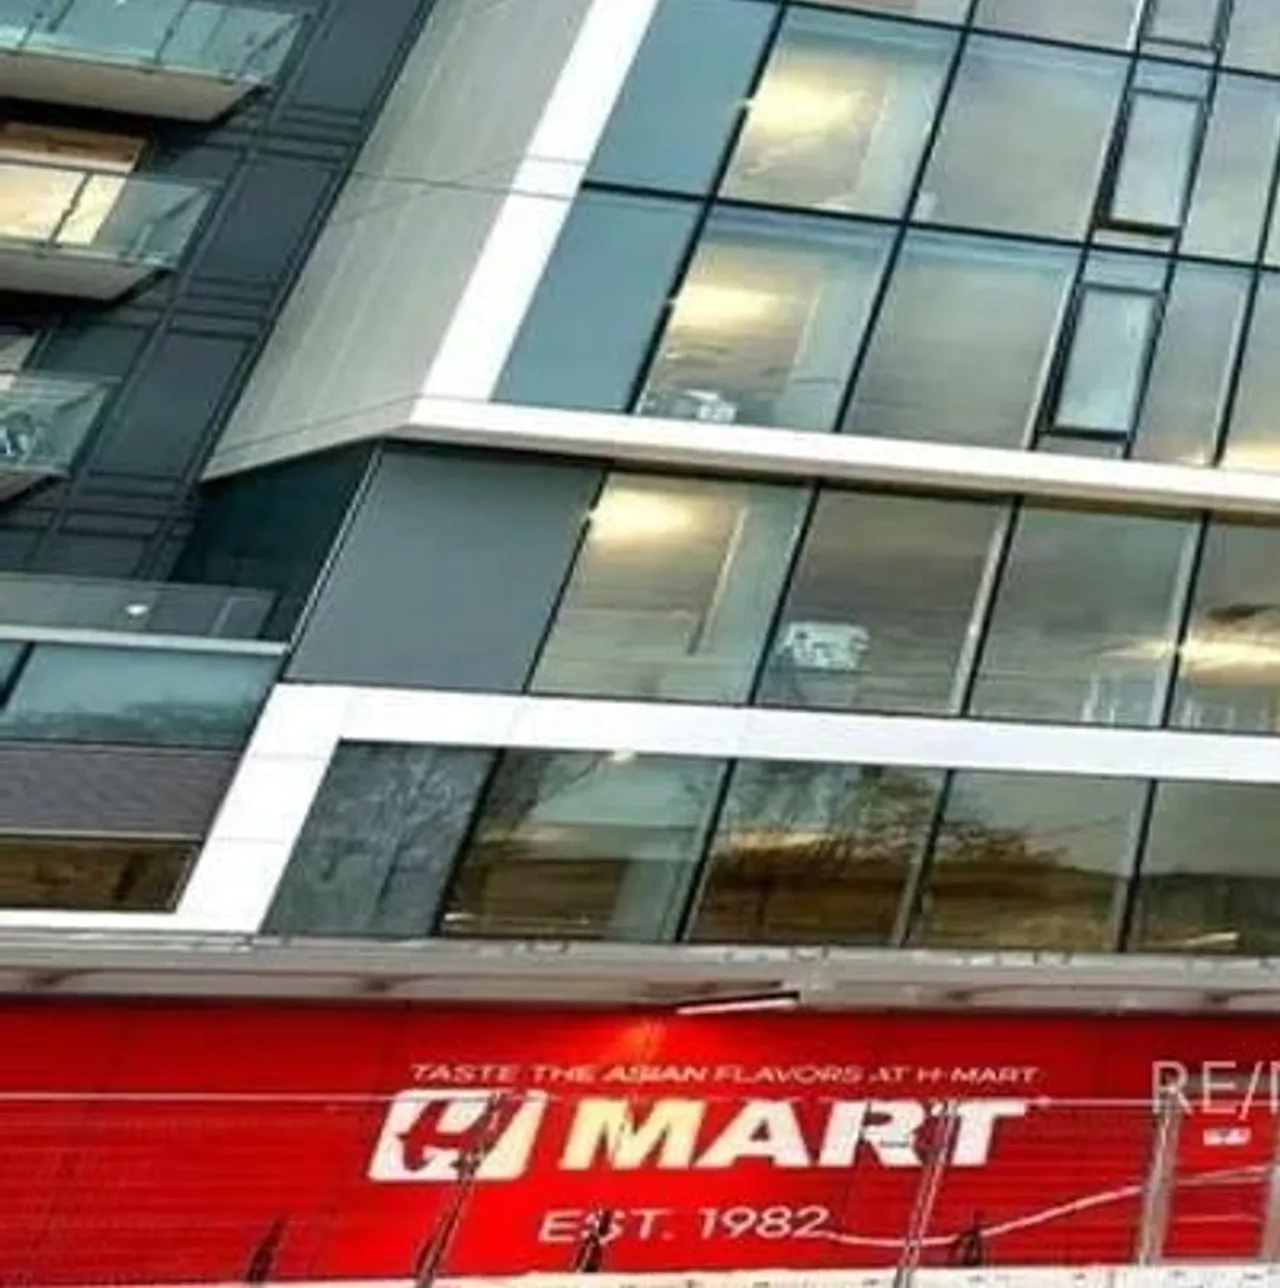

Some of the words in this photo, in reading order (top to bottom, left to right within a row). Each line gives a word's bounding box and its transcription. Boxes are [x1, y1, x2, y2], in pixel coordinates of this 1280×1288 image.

[411, 1064, 517, 1083] TASTE
[530, 1065, 595, 1083] THE
[601, 1065, 707, 1083] ASIAN
[714, 1065, 862, 1084] FLAVORS
[868, 1066, 909, 1083] AT
[558, 1097, 1028, 1170] MART
[538, 1208, 674, 1244] EST.
[698, 1204, 830, 1240] 1982
